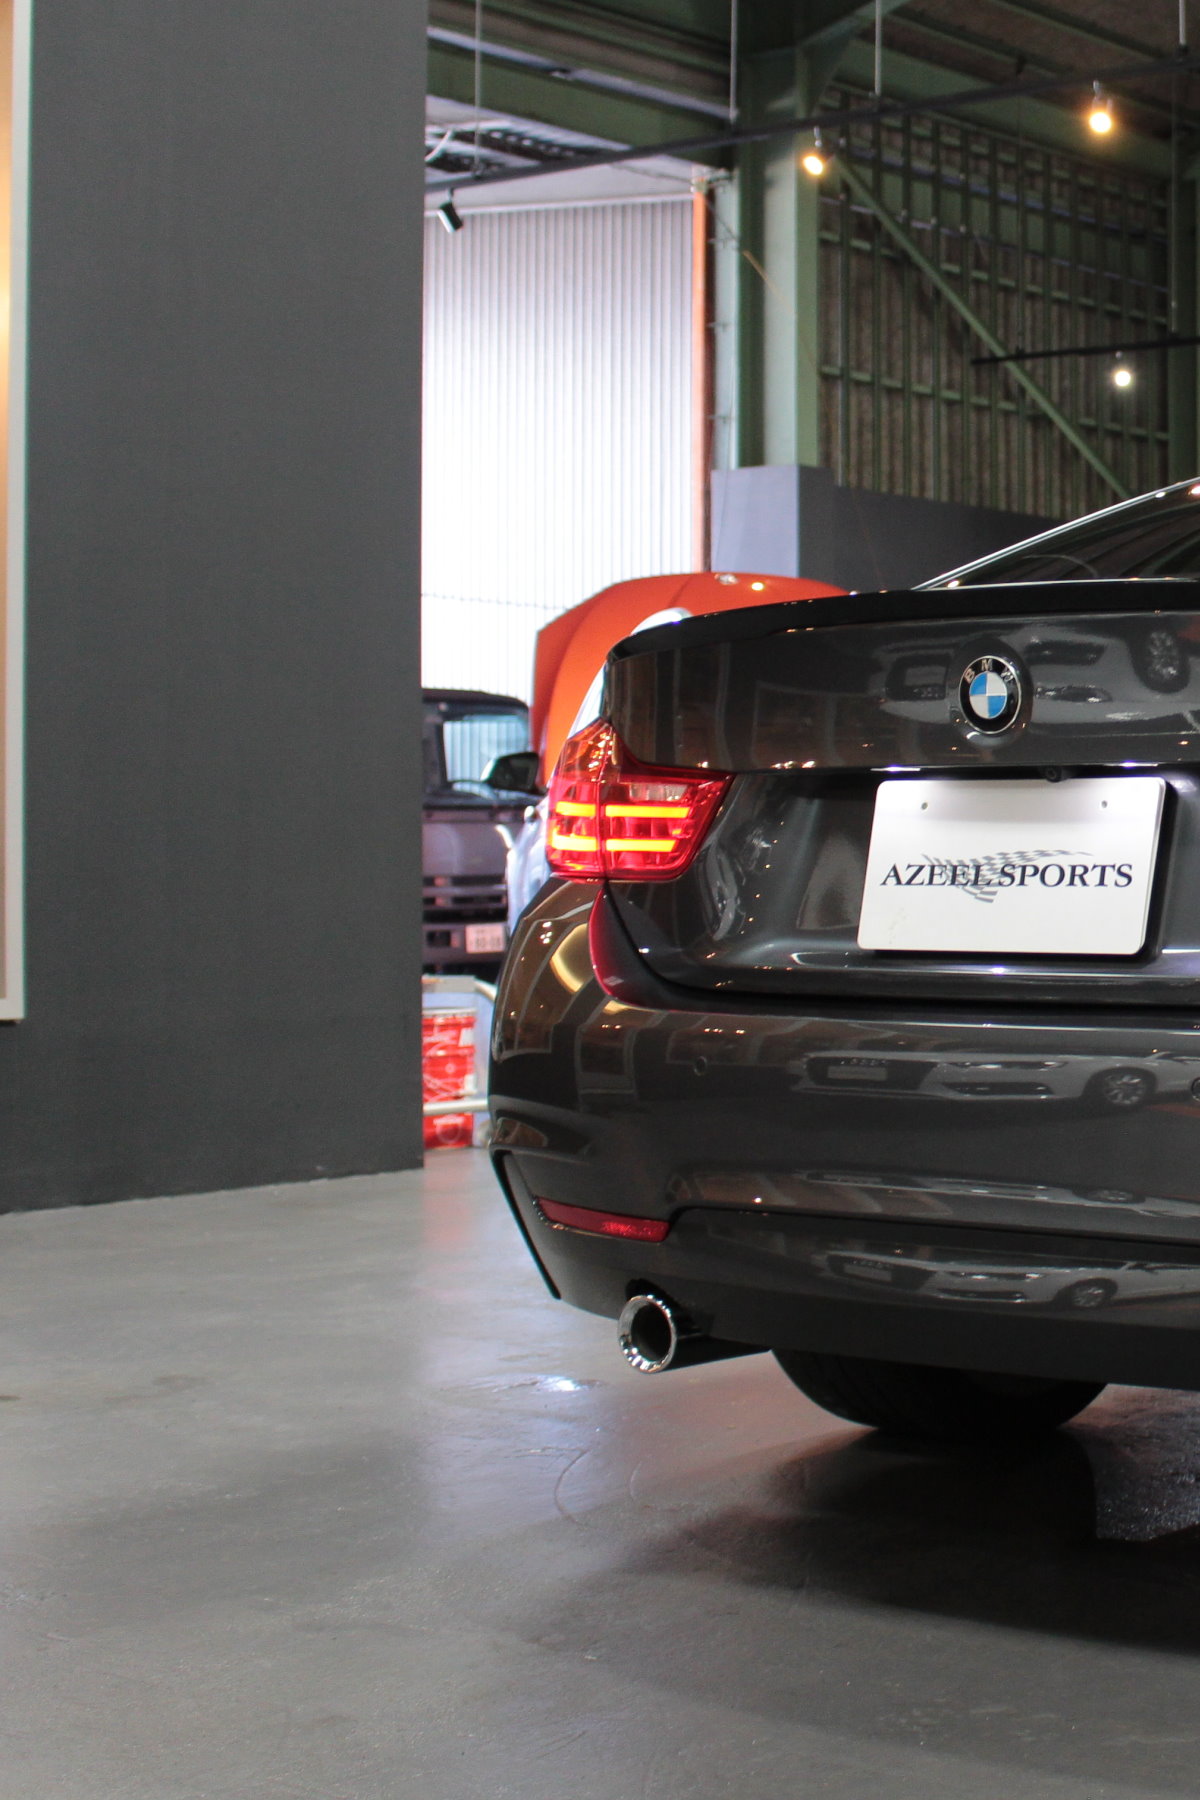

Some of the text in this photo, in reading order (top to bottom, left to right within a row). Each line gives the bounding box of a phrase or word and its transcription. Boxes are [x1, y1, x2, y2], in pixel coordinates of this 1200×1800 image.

[964, 658, 1014, 684] BMW
[880, 863, 1133, 888] AZEEL SPORTS
